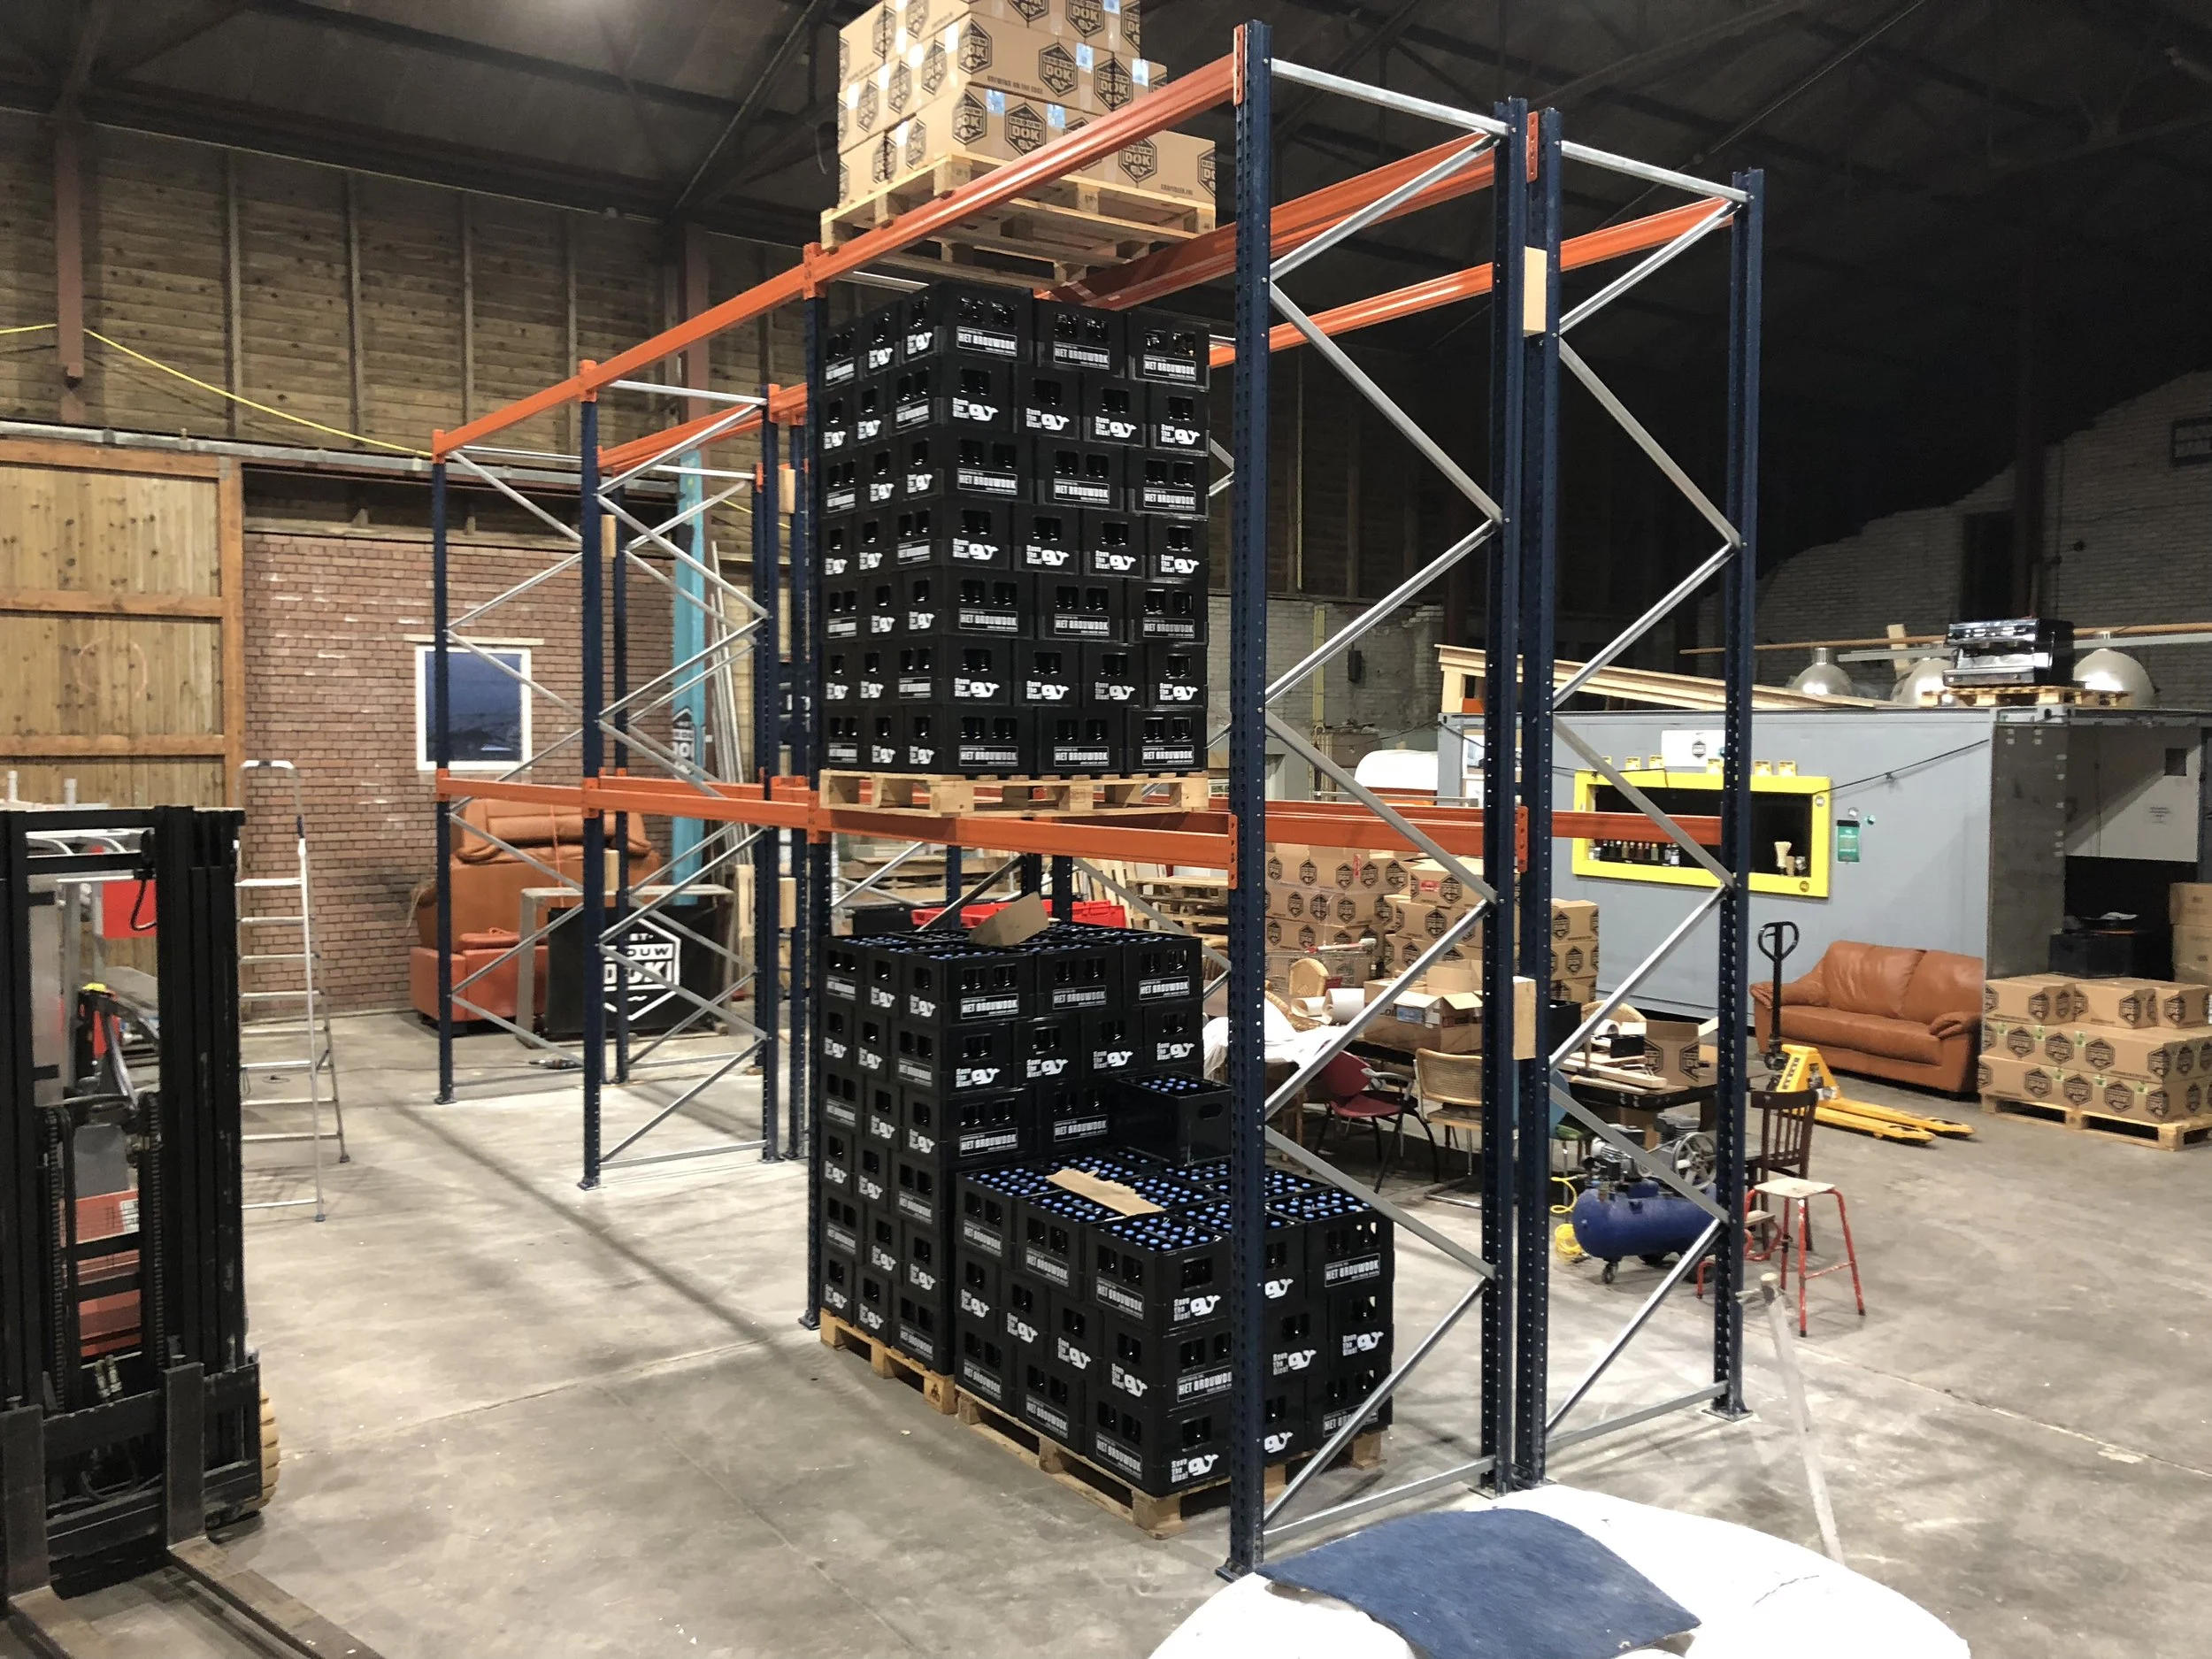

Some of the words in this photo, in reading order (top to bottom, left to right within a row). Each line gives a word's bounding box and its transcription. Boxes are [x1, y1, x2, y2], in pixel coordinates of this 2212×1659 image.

[1072, 7, 1100, 21] DOK
[1045, 65, 1073, 80] DOK
[1011, 125, 1042, 142] DOK
[1125, 152, 1151, 165] DOK
[1194, 1371, 1232, 1391] BROUWDO
